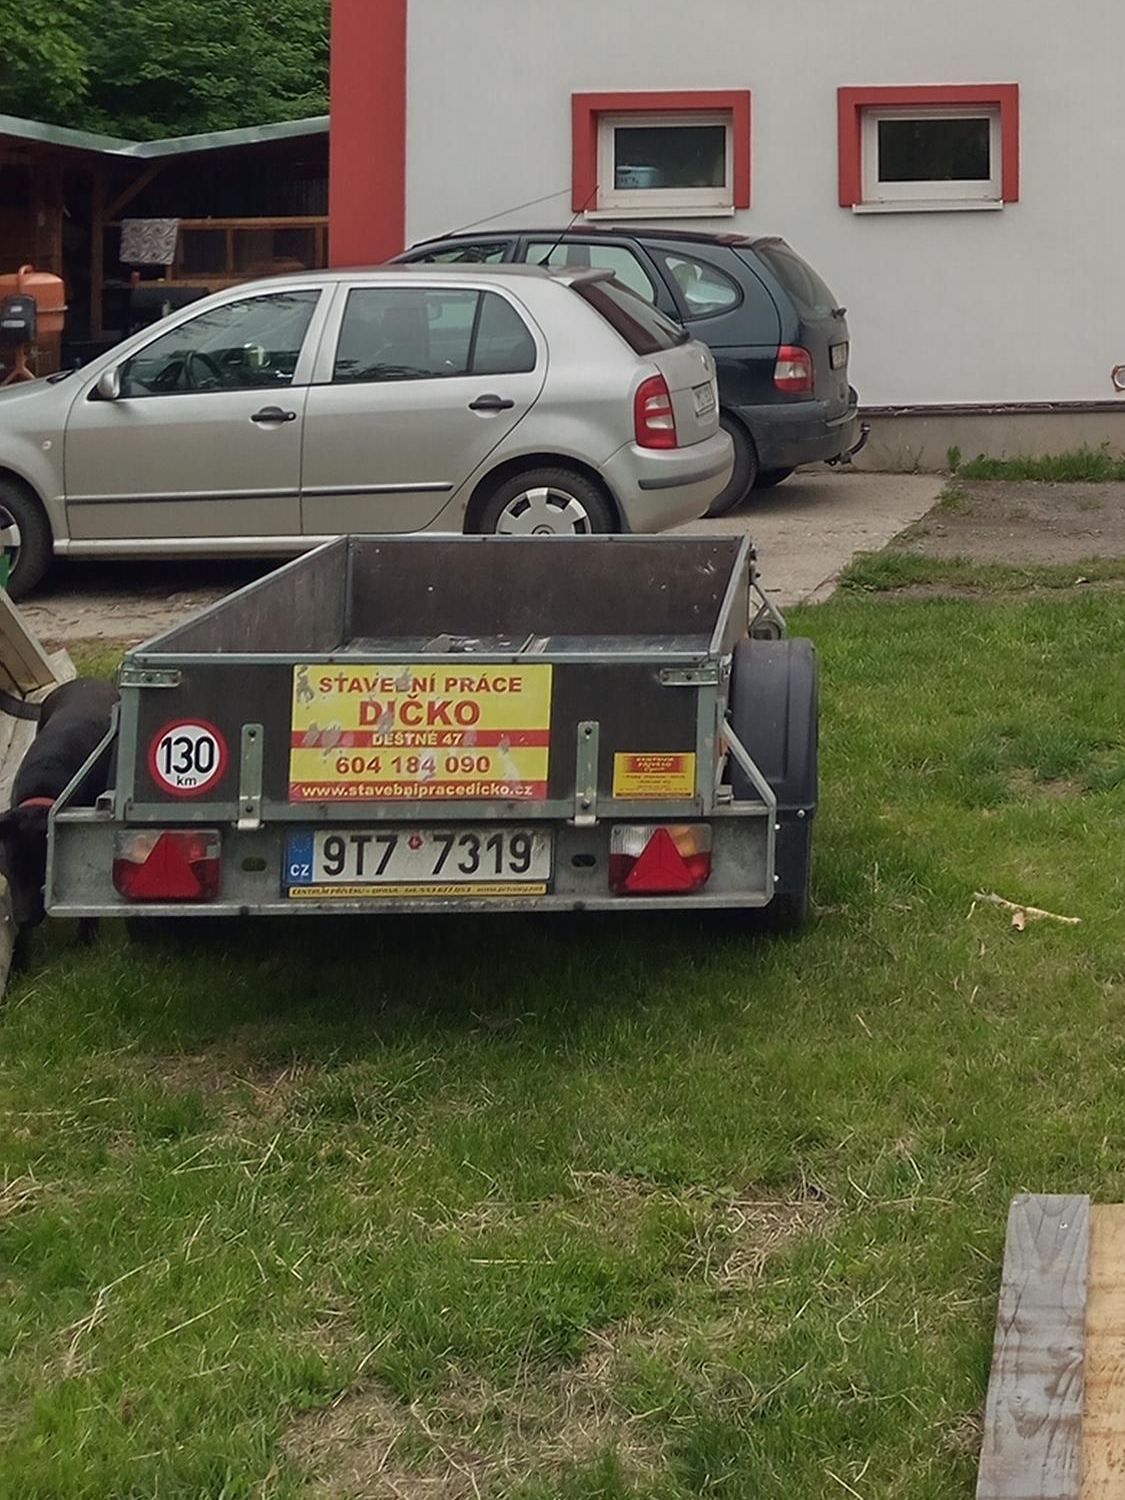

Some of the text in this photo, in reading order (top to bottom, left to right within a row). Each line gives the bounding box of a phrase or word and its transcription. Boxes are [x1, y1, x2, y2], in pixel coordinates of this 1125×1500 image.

[319, 673, 523, 693] STAVENÍ PRÁCE
[359, 694, 481, 726] DIČKO
[442, 733, 463, 746] 47
[161, 736, 214, 774] 130
[336, 756, 490, 774] 604 184 090
[176, 776, 197, 786] km
[302, 782, 533, 797] www.stavebnipracedicko.cz
[290, 832, 532, 877] CZ 9T7 7319
